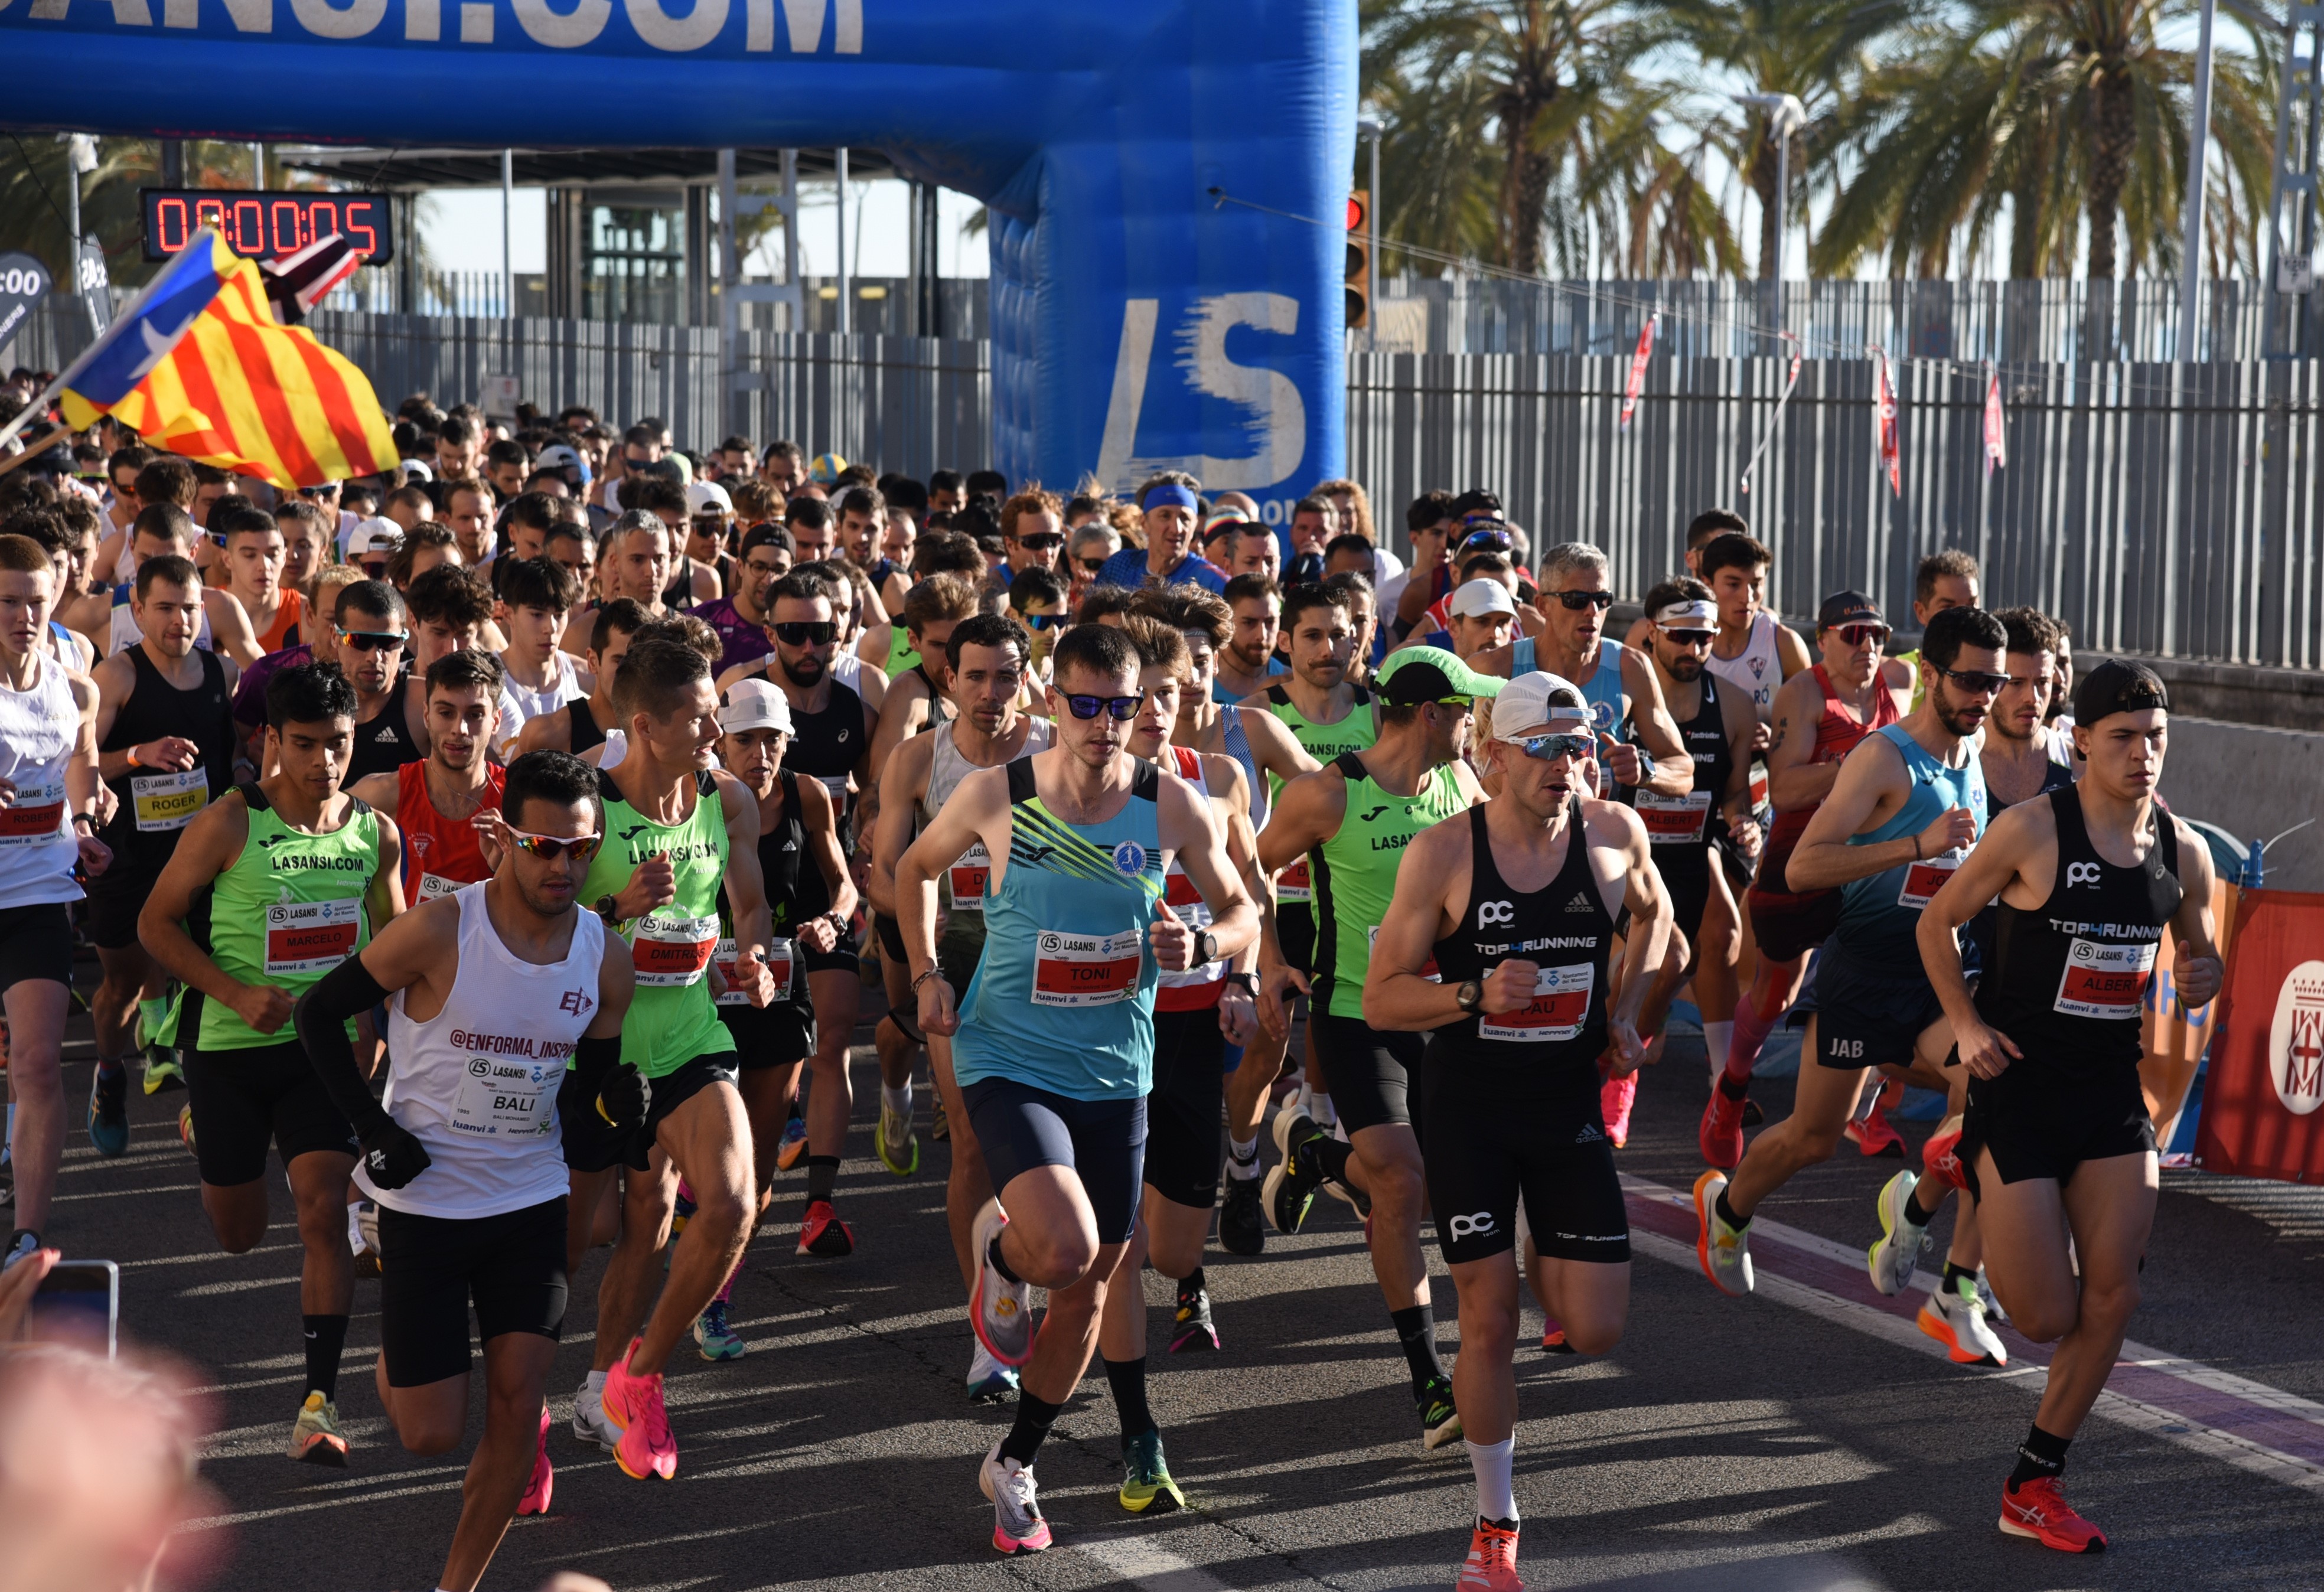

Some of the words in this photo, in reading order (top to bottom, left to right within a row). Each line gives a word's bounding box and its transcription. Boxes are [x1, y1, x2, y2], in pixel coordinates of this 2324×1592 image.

[1094, 292, 1306, 494] LS
[151, 779, 175, 789] LASANSI
[17, 789, 42, 799] LASANSI
[151, 794, 196, 811] ROGER
[14, 811, 58, 824] ROBERTS
[1647, 814, 1693, 825] ALBERT
[272, 855, 364, 872] LASANSI.COM
[2067, 862, 2101, 889] pc
[954, 898, 980, 906] luanvi
[1564, 904, 1595, 913] adidas
[272, 909, 285, 920] LS
[290, 907, 318, 919] LASANSI
[1478, 899, 1514, 931] pc
[643, 918, 657, 929] LS
[661, 922, 692, 934] LASANSI
[286, 932, 342, 947] MARCELO
[1044, 937, 1058, 948] LS
[1064, 939, 1096, 952] LASANSI
[1474, 936, 1598, 955] TOP4RUNNING
[2077, 945, 2090, 957] LS
[2095, 950, 2124, 961] LASANSI
[268, 963, 297, 971] luanvi
[1070, 967, 1110, 981] TONI
[2082, 977, 2140, 991] ALBERT
[1036, 993, 1067, 1003] luanvi
[1520, 1000, 1556, 1015] PAU
[2059, 1000, 2090, 1013] luanvi
[1484, 1027, 1515, 1037] luanvi
[1828, 1038, 1864, 1058] JAB
[472, 1061, 488, 1074] LS
[493, 1065, 527, 1079] LASANSI
[493, 1095, 535, 1112] BALI
[452, 1120, 486, 1133] luanvi
[1575, 1133, 1604, 1144] adidas
[1449, 1212, 1495, 1243] pc
[1482, 1228, 1501, 1238] team
